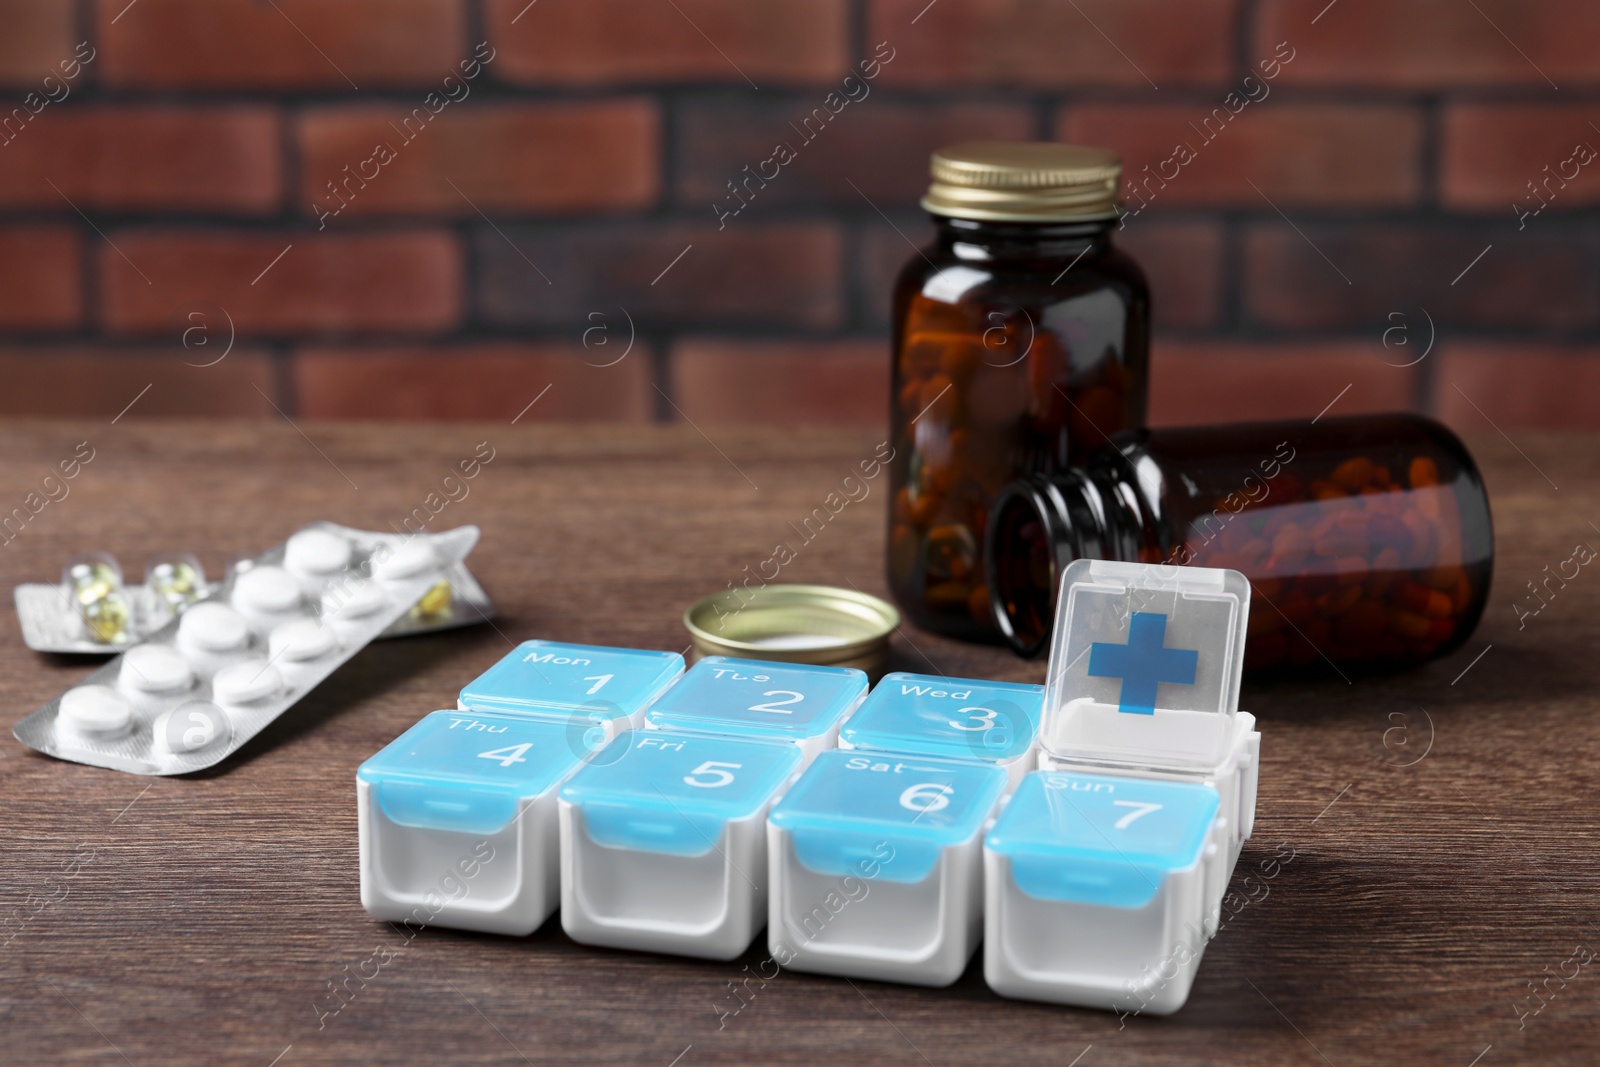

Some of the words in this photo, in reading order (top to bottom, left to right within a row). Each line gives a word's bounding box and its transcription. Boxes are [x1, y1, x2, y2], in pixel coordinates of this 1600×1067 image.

[521, 651, 592, 667] Mon
[583, 673, 614, 695] 1
[901, 684, 973, 700] Wed
[747, 690, 805, 715] 2
[448, 718, 509, 734] Thu
[949, 707, 998, 732] 3
[476, 742, 534, 767] 4
[636, 738, 688, 752] Fri
[683, 760, 743, 788] 5
[845, 757, 907, 774] Sat
[1046, 776, 1115, 794] Sun
[899, 782, 955, 812] 6
[1112, 799, 1163, 830] 7
